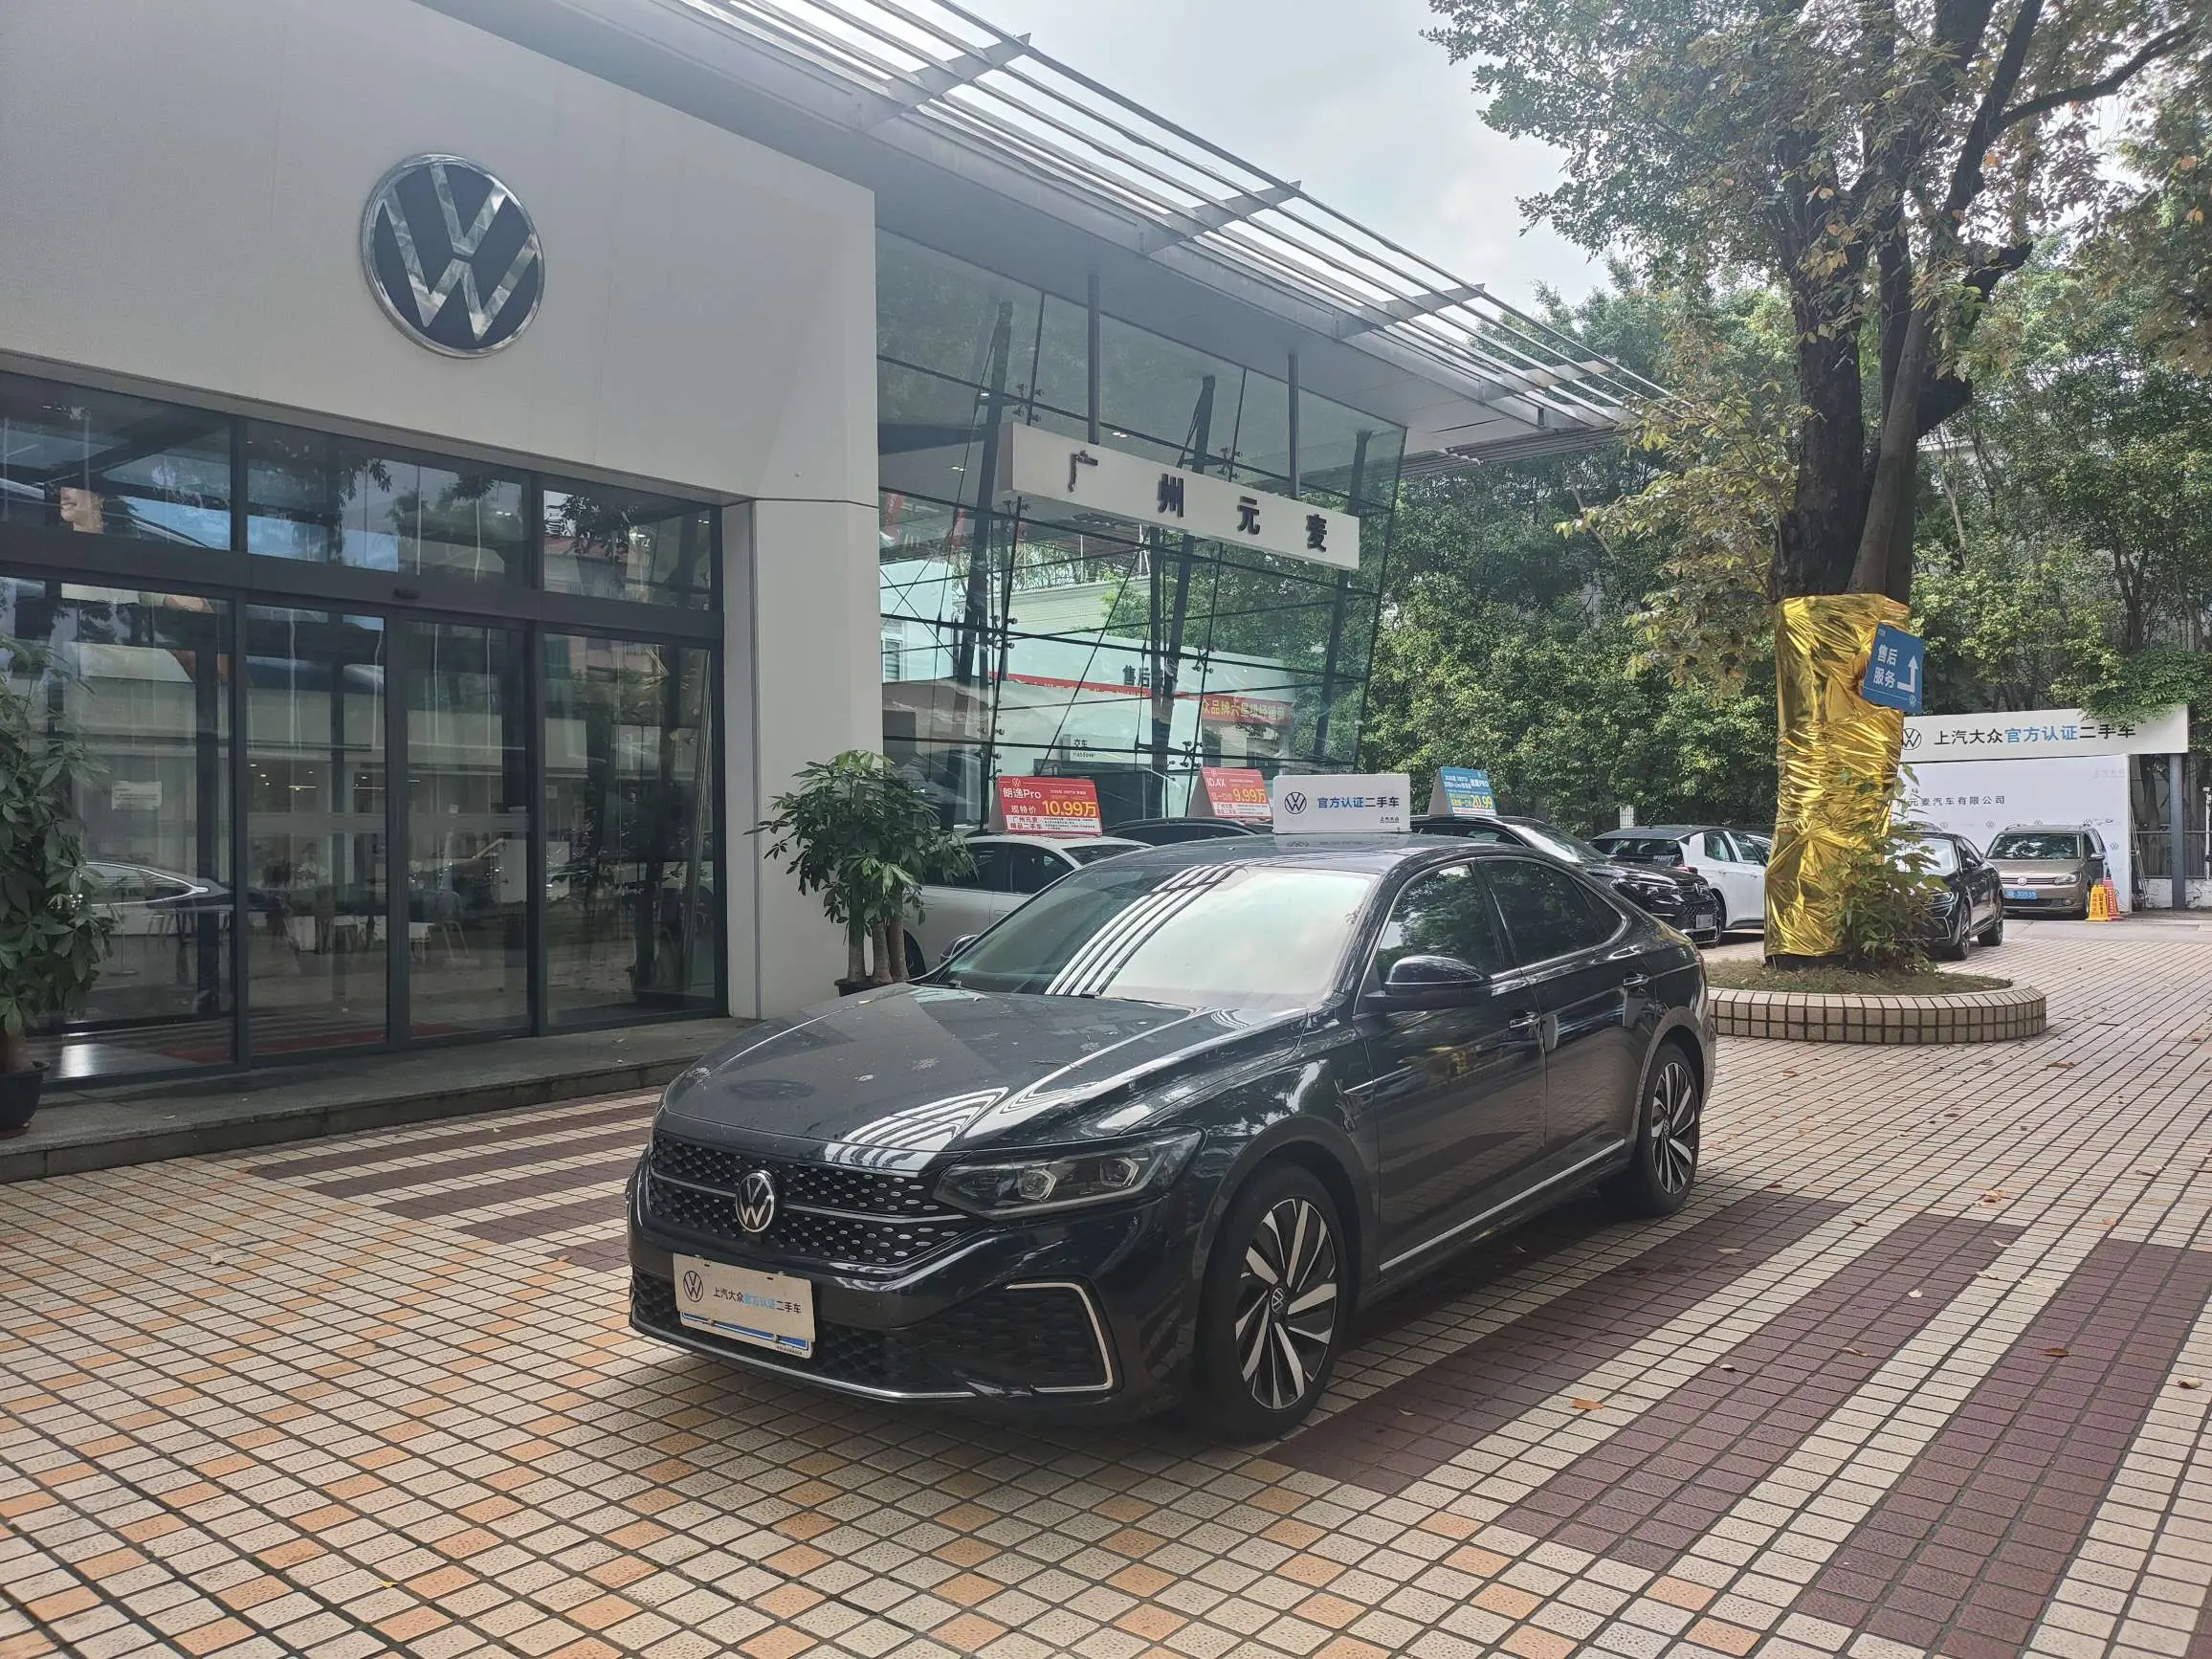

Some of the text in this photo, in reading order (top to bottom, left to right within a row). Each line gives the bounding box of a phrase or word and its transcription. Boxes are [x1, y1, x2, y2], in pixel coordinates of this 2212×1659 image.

[1067, 450, 1328, 553] 广州元麦
[1877, 644, 1898, 666] 售后
[1873, 667, 1895, 688] 服务
[1934, 723, 2135, 746] 上汽大众官方认证二手车
[1003, 787, 1042, 799] 朗逸Pro
[1232, 787, 1267, 803] 9.99万
[1010, 805, 1036, 814] 现特价
[1041, 800, 1096, 817] 10.99万
[1317, 796, 1400, 809] 官方认证二手车
